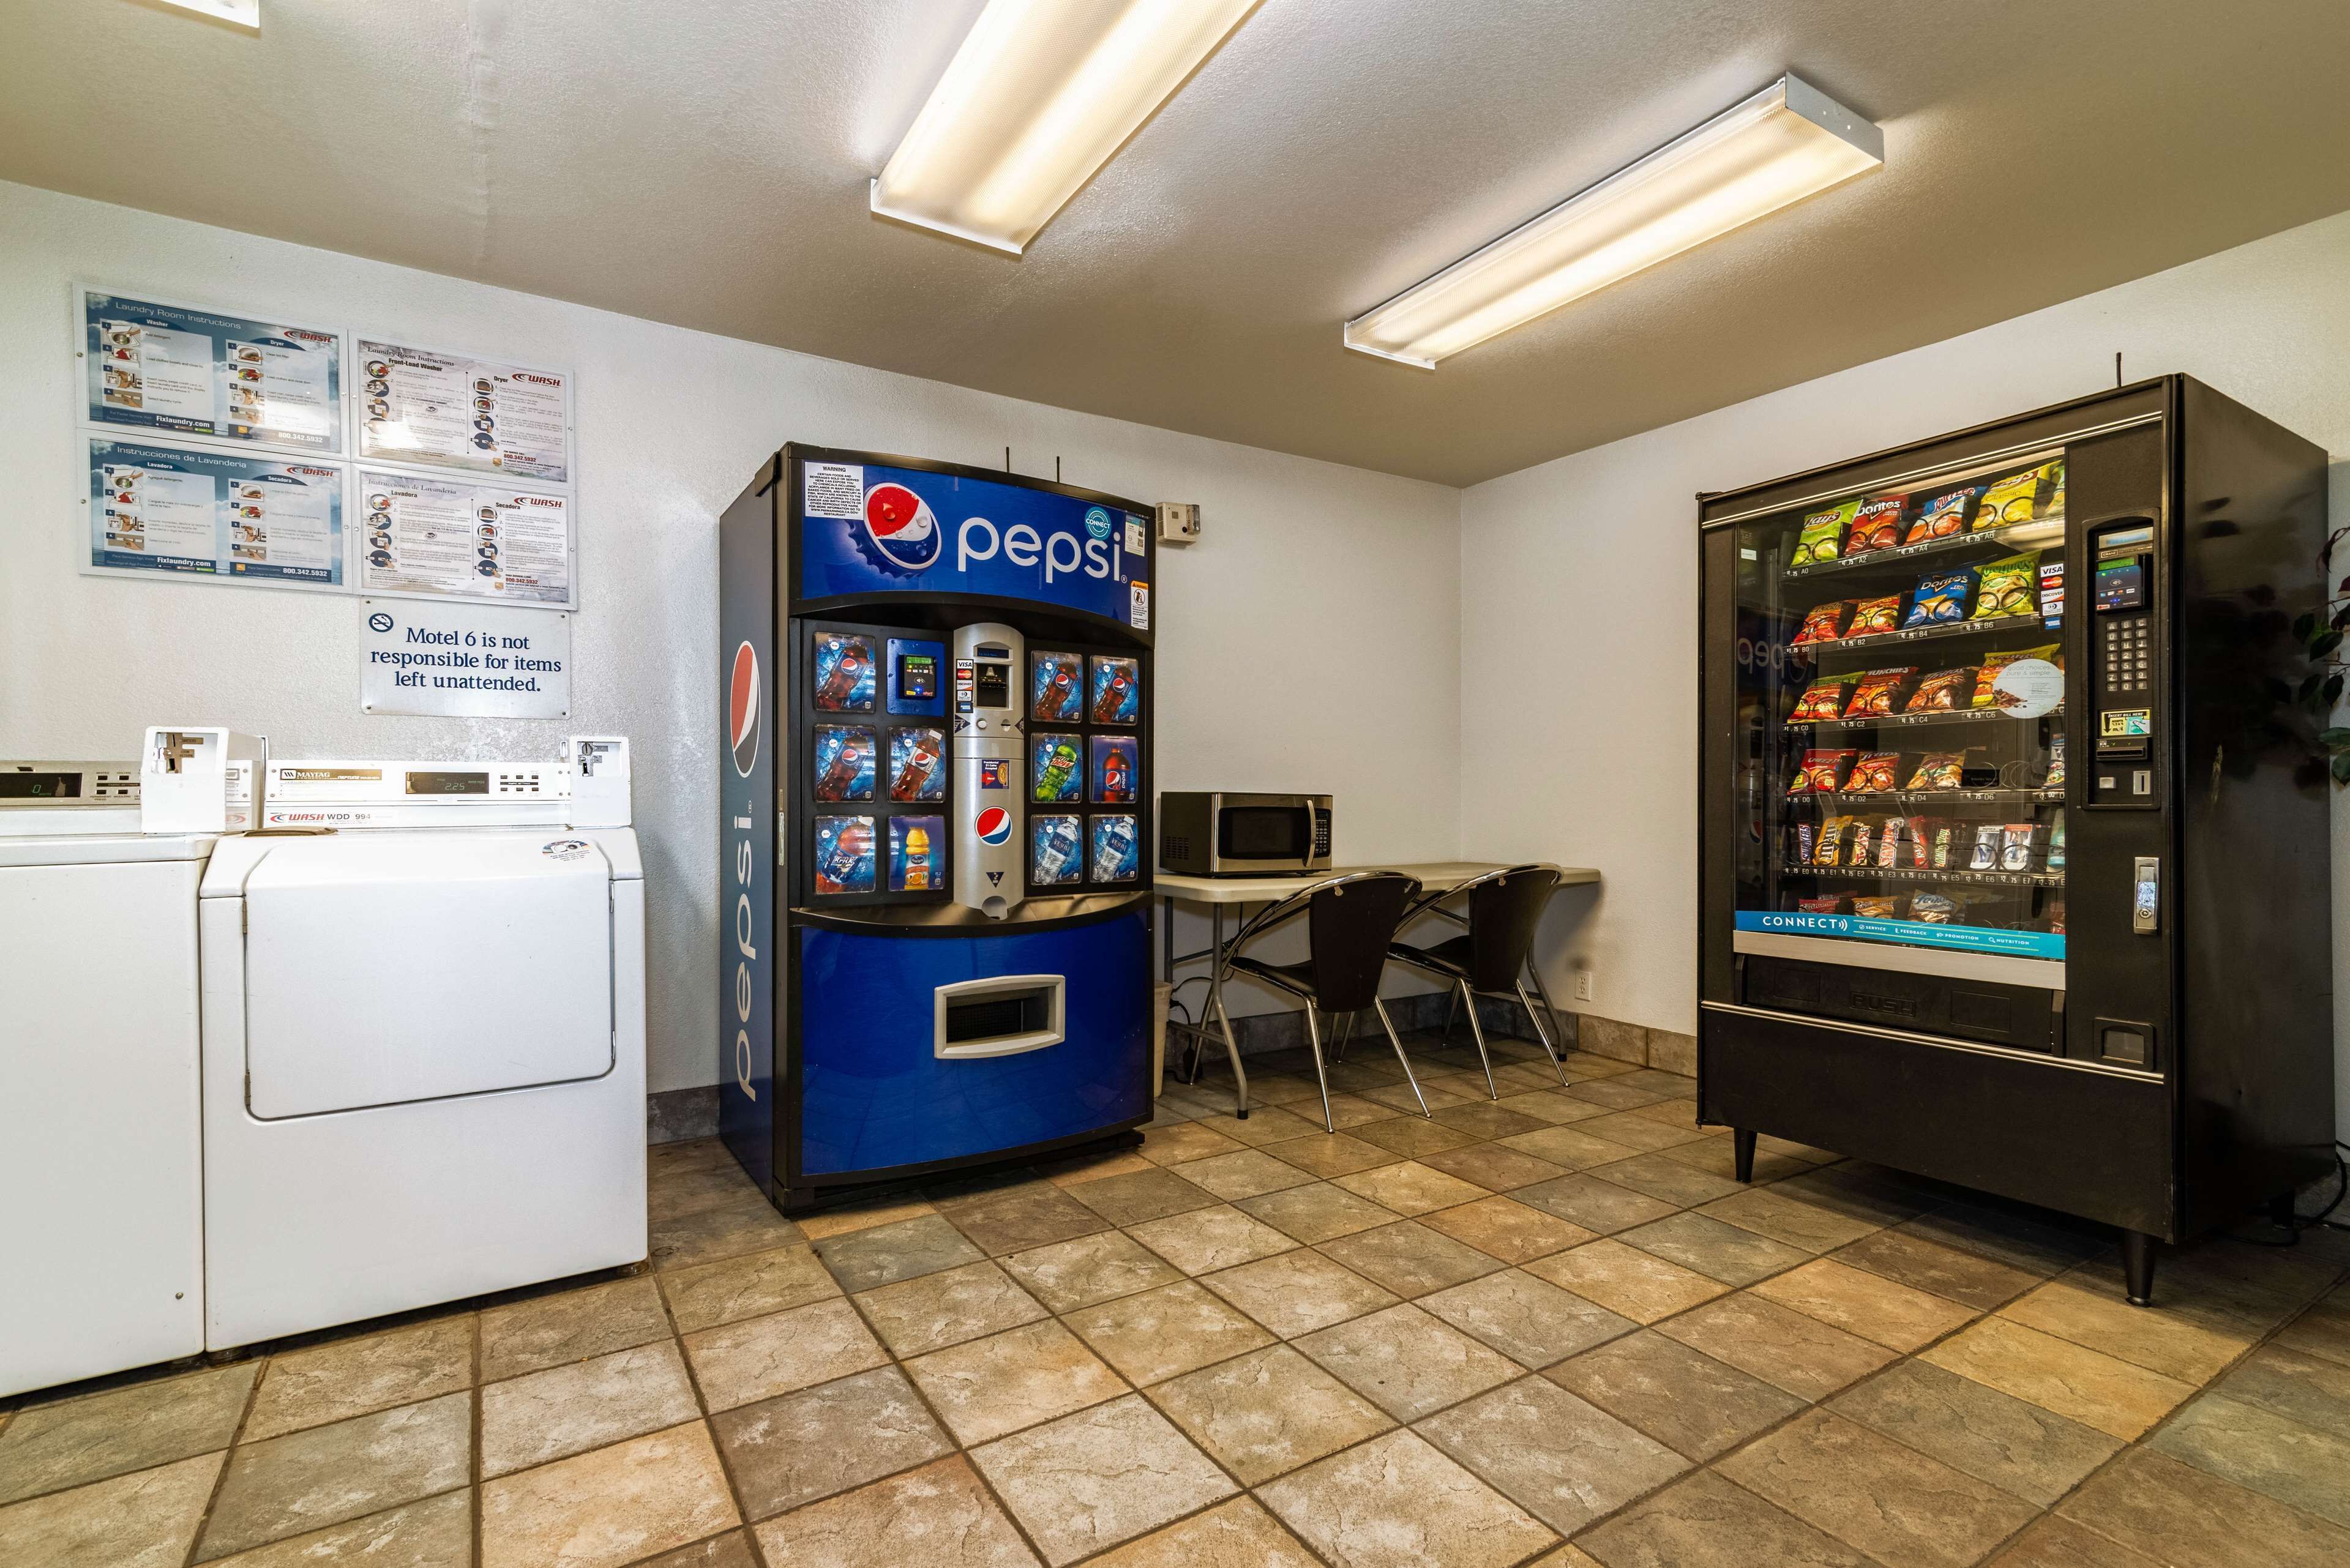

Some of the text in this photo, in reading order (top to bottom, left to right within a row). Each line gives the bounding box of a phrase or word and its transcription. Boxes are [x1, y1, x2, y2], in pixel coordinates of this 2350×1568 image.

[116, 302, 241, 329] Laundry Room Instructions
[147, 319, 168, 327] Washer
[299, 332, 331, 343] WASH
[367, 346, 454, 366] Laundry Room Instructions
[389, 358, 443, 372] Front-Load Washer
[528, 375, 561, 387] WASH
[156, 415, 210, 428] Fixlaundry.com
[279, 431, 323, 443] 800.342.5932
[118, 446, 181, 460] Instrucciones
[504, 454, 536, 462] 800.342.5932
[302, 468, 334, 477] WASH
[369, 479, 410, 489] Instrucciones
[1986, 490, 2021, 502] Classic
[530, 498, 562, 508] WASH
[1086, 518, 1110, 529] CONNECT
[958, 517, 1120, 584] pepsi
[157, 557, 211, 567] Fixlaundry.com
[283, 567, 327, 577] 800.342.5932
[2043, 566, 2063, 575] VISA
[1920, 575, 1968, 591] Doritos
[405, 627, 531, 650] Motel 6 is not
[370, 651, 561, 672] responsible for items
[394, 671, 541, 692] left unattended.
[1763, 916, 1837, 928] CONNECT
[734, 816, 757, 1102] pepsi
